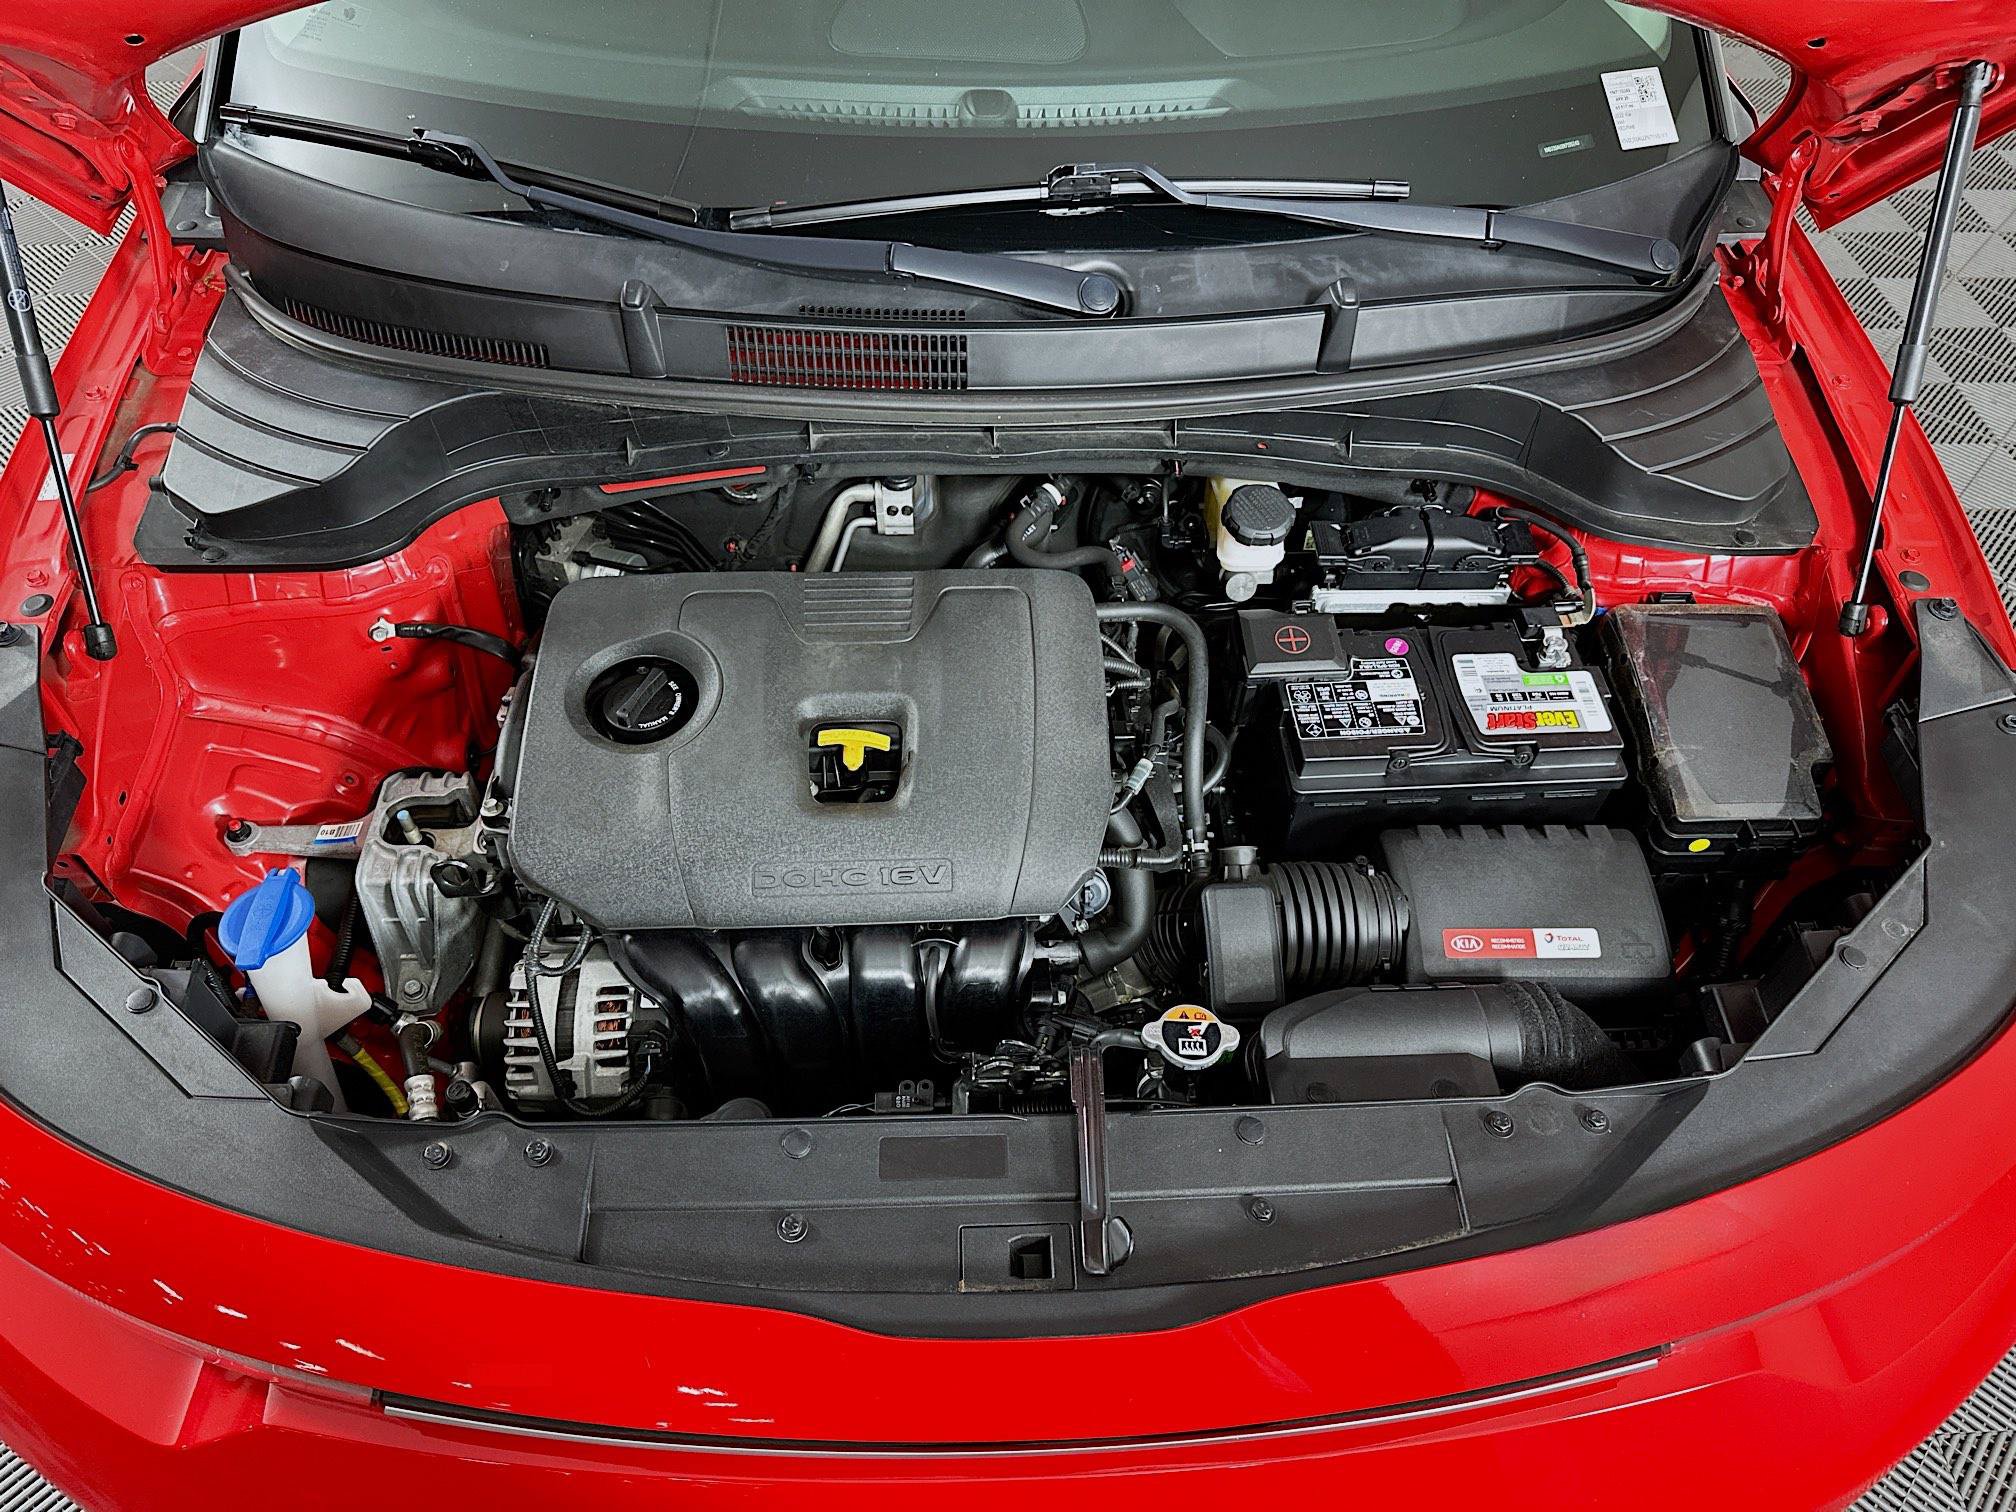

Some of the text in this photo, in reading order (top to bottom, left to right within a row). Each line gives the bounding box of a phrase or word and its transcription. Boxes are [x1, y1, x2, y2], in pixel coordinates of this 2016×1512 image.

[637, 680, 682, 729] SEE OWNER'S MANUAL
[1489, 704, 1533, 712] PLATINUM
[1487, 709, 1581, 731] EverStart
[753, 864, 949, 889] DOHC 16V
